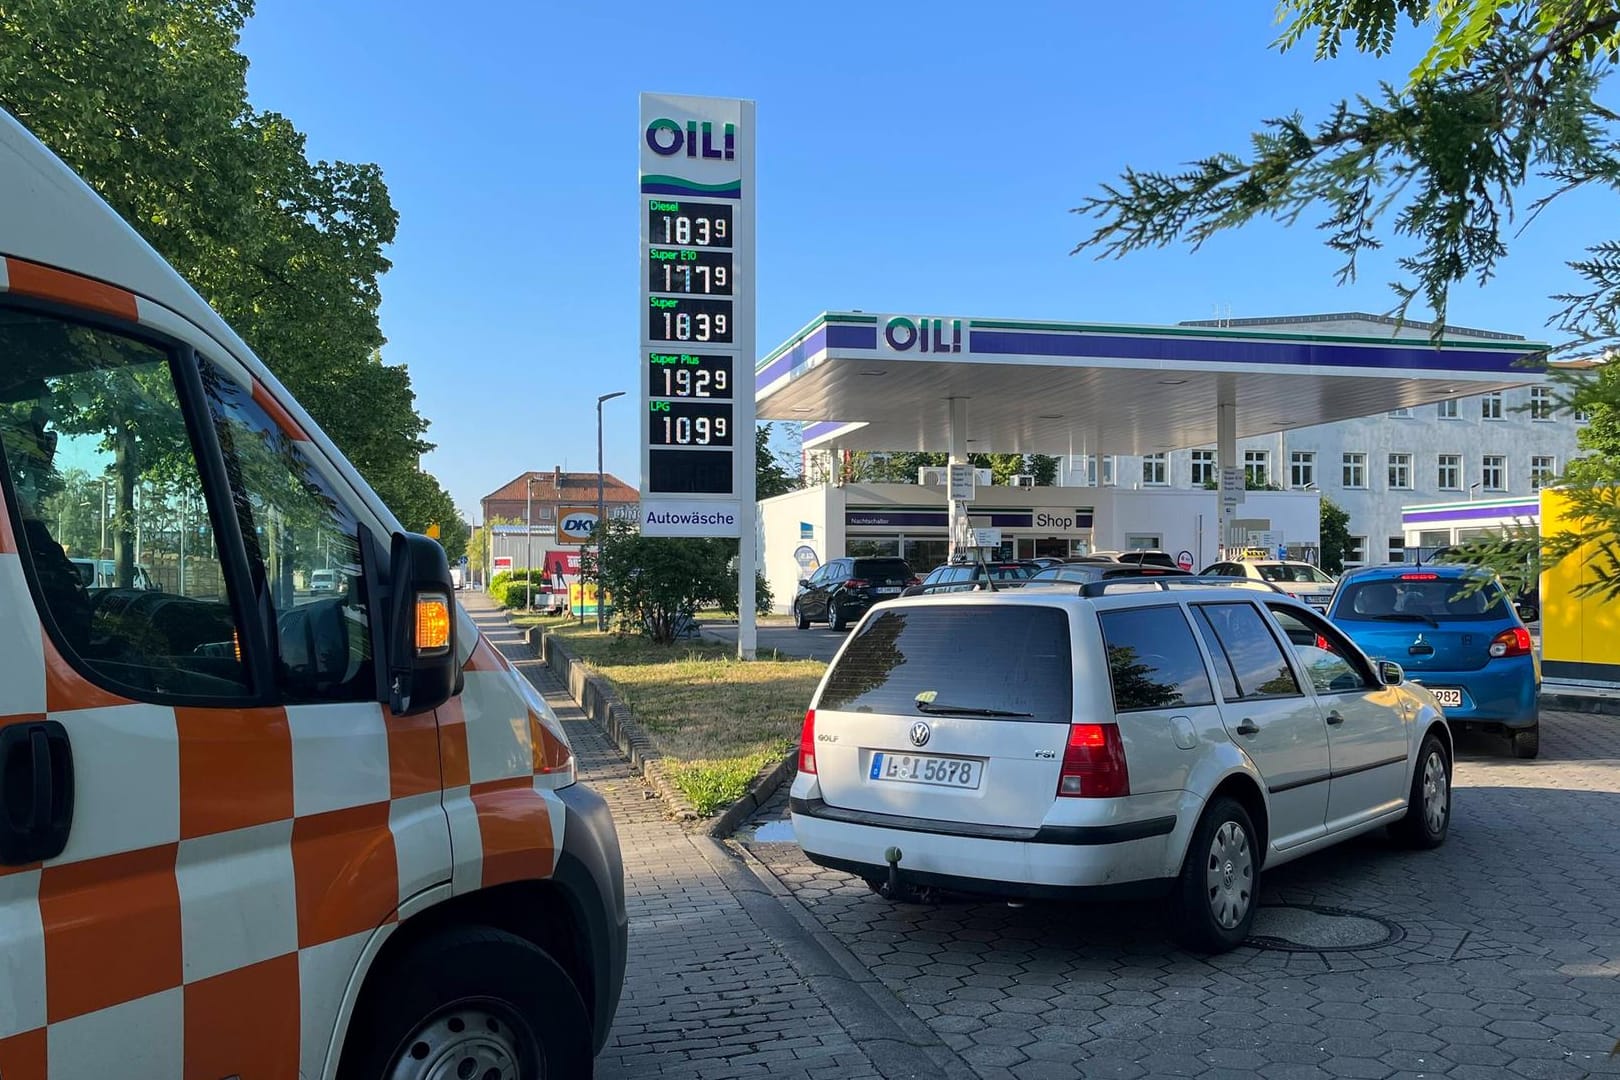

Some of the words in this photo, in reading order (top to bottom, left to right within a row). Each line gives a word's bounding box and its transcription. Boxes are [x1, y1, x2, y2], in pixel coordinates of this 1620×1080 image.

[646, 118, 735, 161] OIL!
[650, 201, 679, 212] Diesel
[650, 249, 677, 261] Super
[681, 250, 697, 261] E10
[650, 298, 677, 309] Super
[885, 317, 961, 353] OIL!
[650, 354, 677, 365] Super
[681, 354, 700, 365] Plus
[650, 402, 671, 412] LPG
[646, 511, 735, 525] Autowäsche
[1036, 513, 1073, 530] Shop
[1431, 689, 1460, 704] 982
[817, 734, 840, 743] GOLF
[1034, 749, 1056, 760] FSI
[923, 760, 972, 785] 5678
